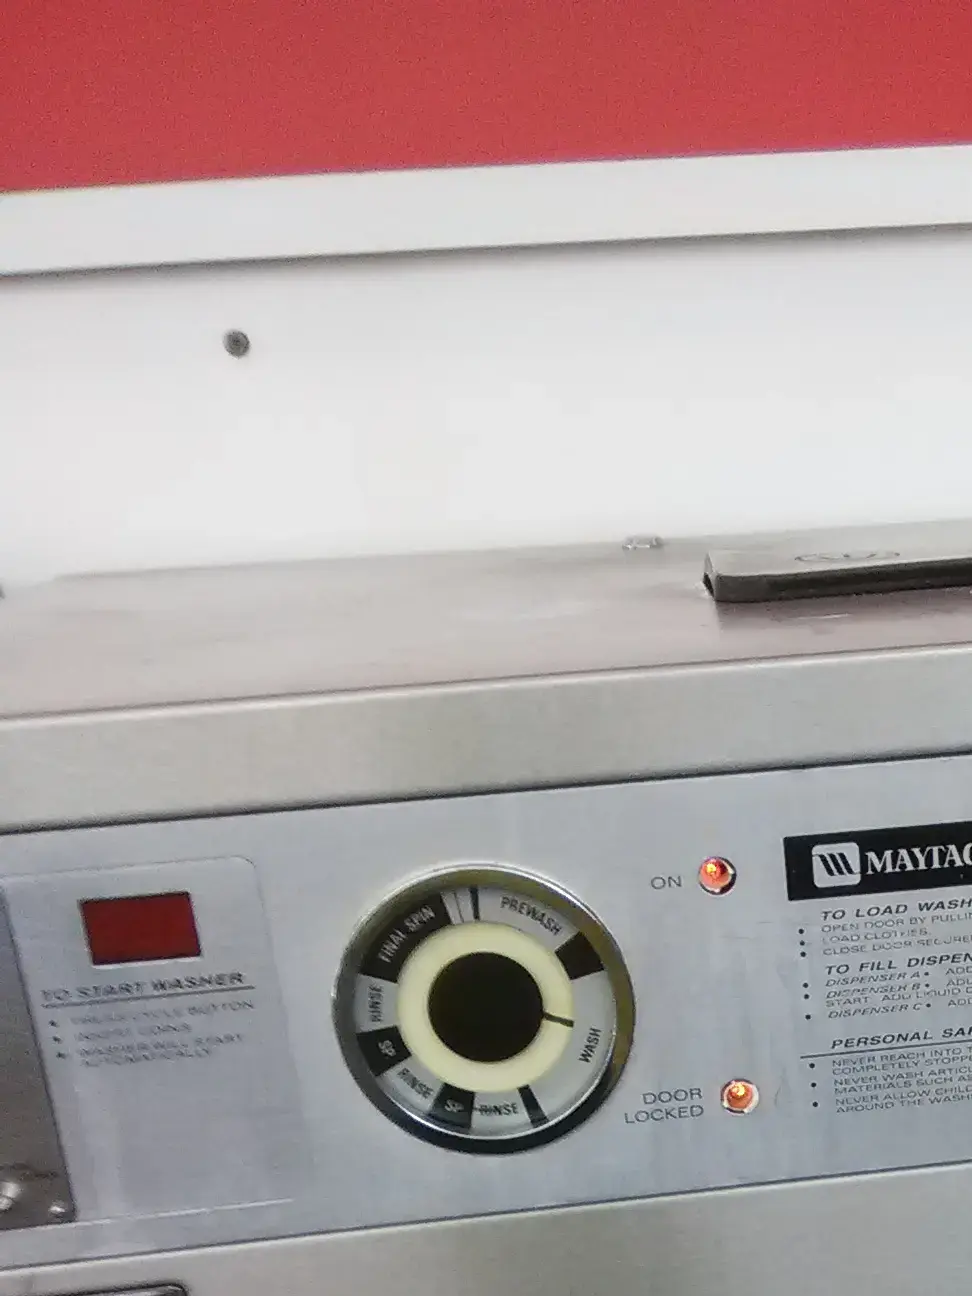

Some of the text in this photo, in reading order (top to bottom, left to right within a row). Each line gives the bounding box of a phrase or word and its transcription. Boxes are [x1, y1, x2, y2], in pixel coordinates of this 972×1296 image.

[650, 875, 682, 890] ON
[500, 896, 563, 936] PREWASH
[821, 910, 846, 922] TO
[855, 905, 908, 918] LOAD
[821, 922, 859, 933] OPEN
[864, 919, 904, 929] DOOR
[909, 916, 926, 926] BY
[379, 906, 436, 963] FINAL SPIN
[822, 933, 860, 945] LOAD
[822, 946, 866, 956] CLOSE
[872, 940, 913, 952] DOOR
[825, 964, 849, 975] TO
[858, 960, 896, 972] FILL
[825, 971, 907, 987] DISPENSER
[75, 981, 145, 998] START
[826, 983, 907, 999] DISPENSER
[881, 991, 912, 1002] ADD
[916, 986, 961, 999] LIQUID
[368, 984, 383, 1023] RINSE
[827, 1004, 911, 1020] DISPENSER
[912, 1003, 923, 1012] C
[579, 1028, 601, 1064] WASH
[831, 1031, 932, 1049] PERSONAL
[832, 1056, 876, 1067] NEVER
[880, 1051, 926, 1063] REACH
[929, 1046, 962, 1057] INTO
[832, 1060, 920, 1076] COMPLETELY
[397, 1068, 435, 1099] RINSE
[833, 1075, 878, 1087] NEVER
[881, 1071, 924, 1081] WASH
[834, 1081, 913, 1095] MATERIALS
[916, 1077, 954, 1088] SUCH
[643, 1087, 703, 1105] DOOR
[835, 1093, 880, 1106] NEVER
[883, 1088, 931, 1101] ALLOW
[477, 1102, 519, 1116] RINSE
[625, 1104, 704, 1124] LOCKED
[836, 1101, 895, 1114] AROUND
[901, 1098, 925, 1108] THE
